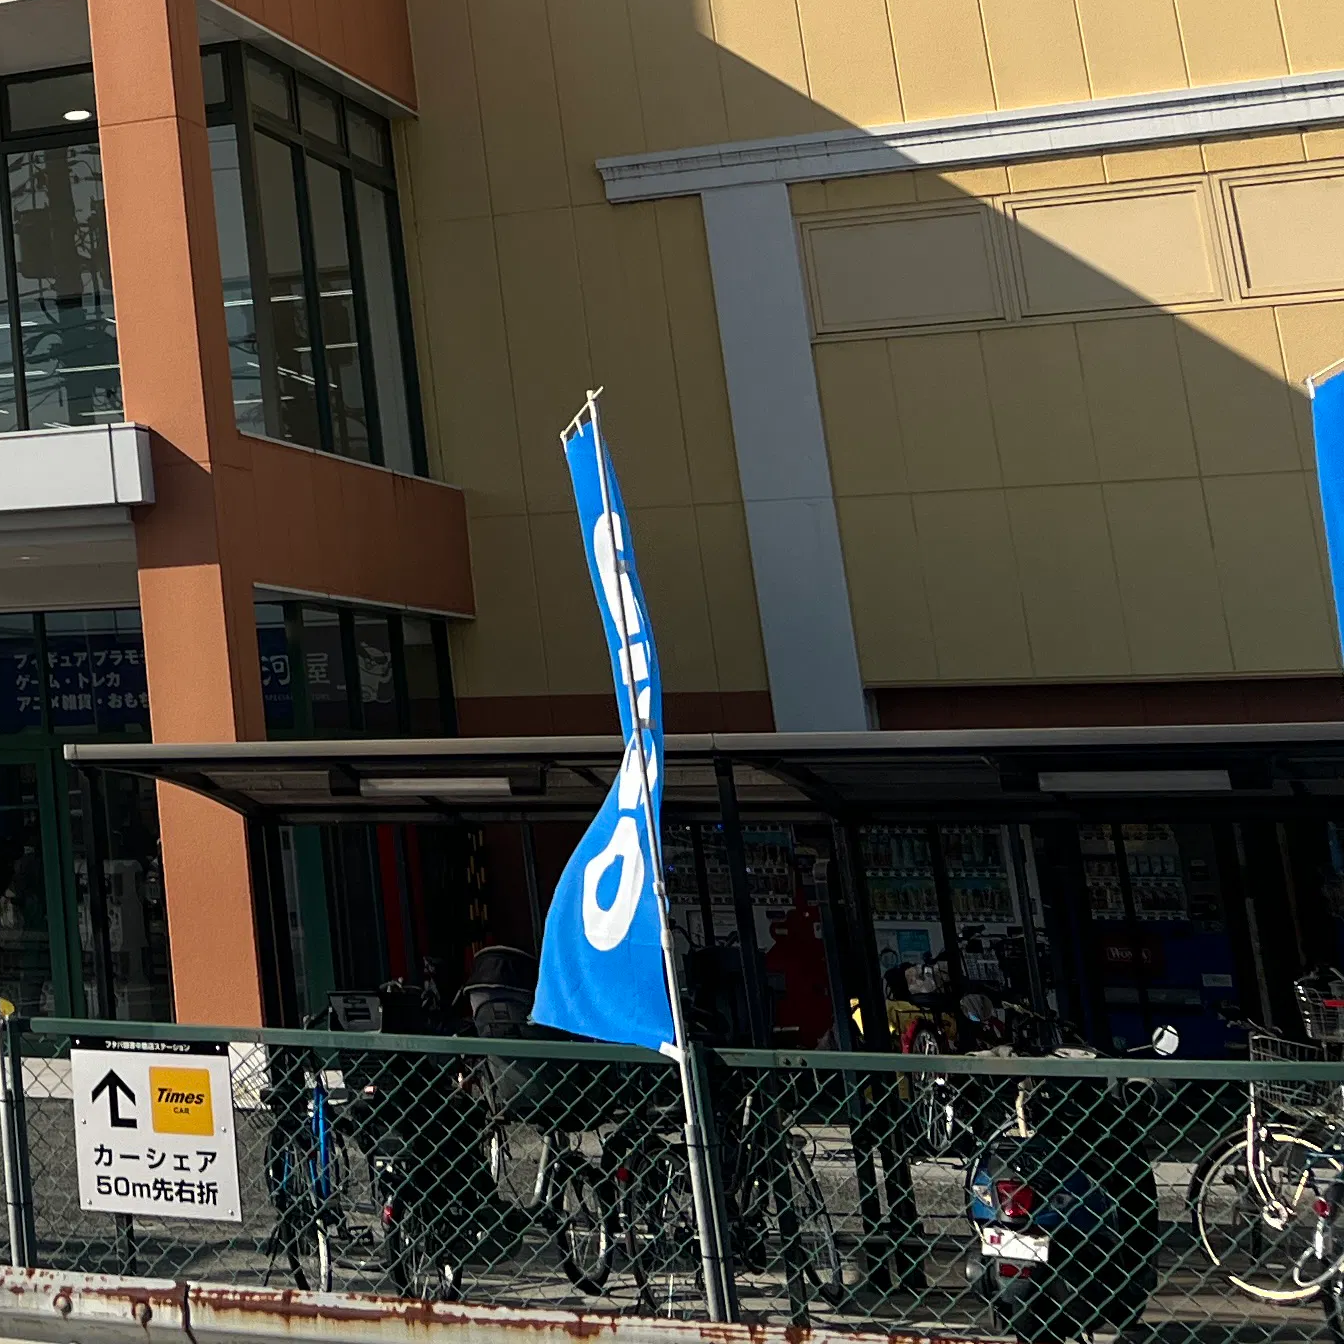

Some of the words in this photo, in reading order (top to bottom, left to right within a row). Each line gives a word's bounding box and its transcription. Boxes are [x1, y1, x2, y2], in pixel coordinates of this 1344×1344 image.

[92, 648, 145, 667] プラモ
[156, 1087, 205, 1105] Times
[93, 1143, 217, 1173] カーシェア
[96, 1174, 219, 1206] 50m先右折
